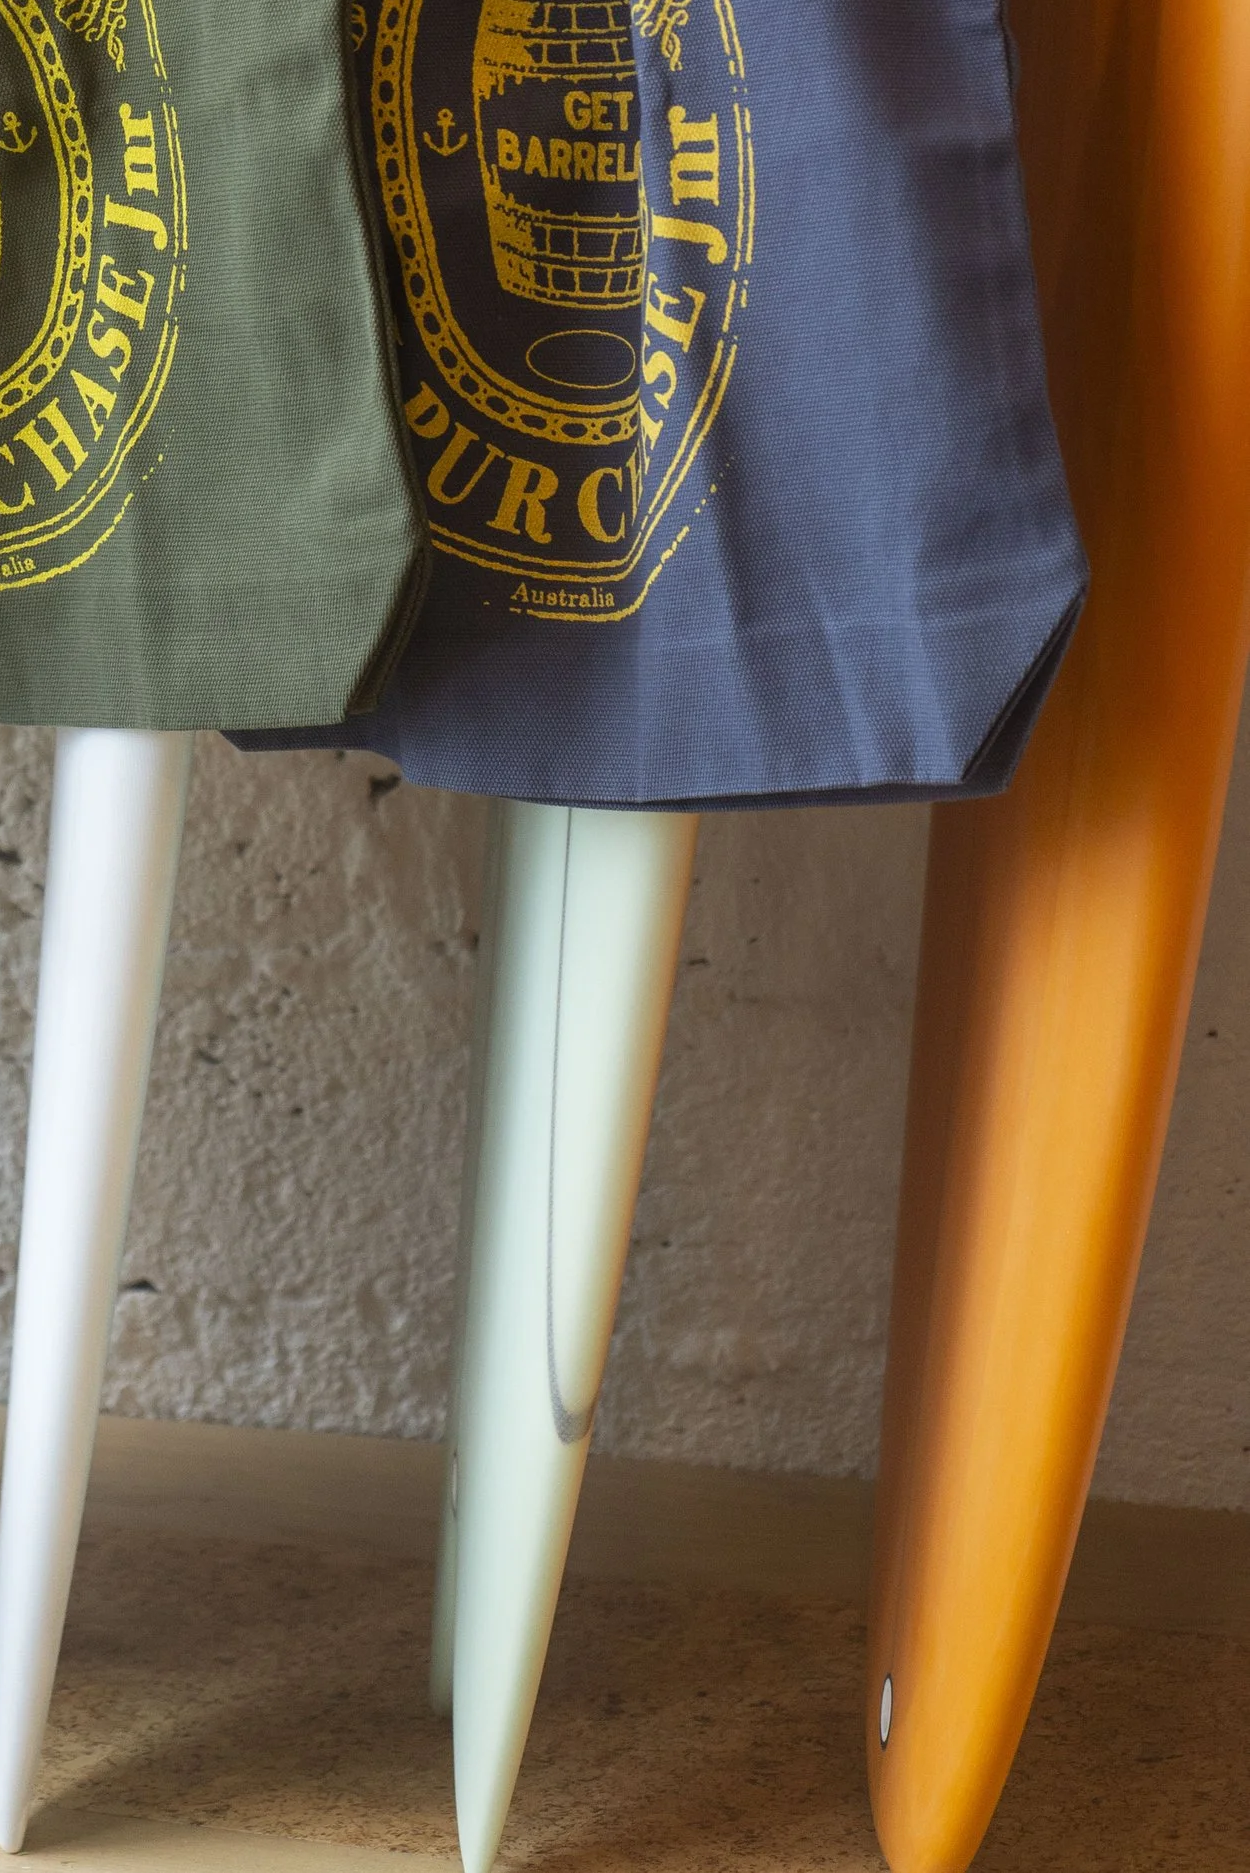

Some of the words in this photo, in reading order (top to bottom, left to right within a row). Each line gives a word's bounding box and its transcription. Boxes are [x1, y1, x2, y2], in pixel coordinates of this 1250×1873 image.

[563, 90, 635, 132] GET
[104, 102, 168, 251] Jnr
[496, 128, 642, 183] BARREL
[509, 582, 616, 609] Australia
